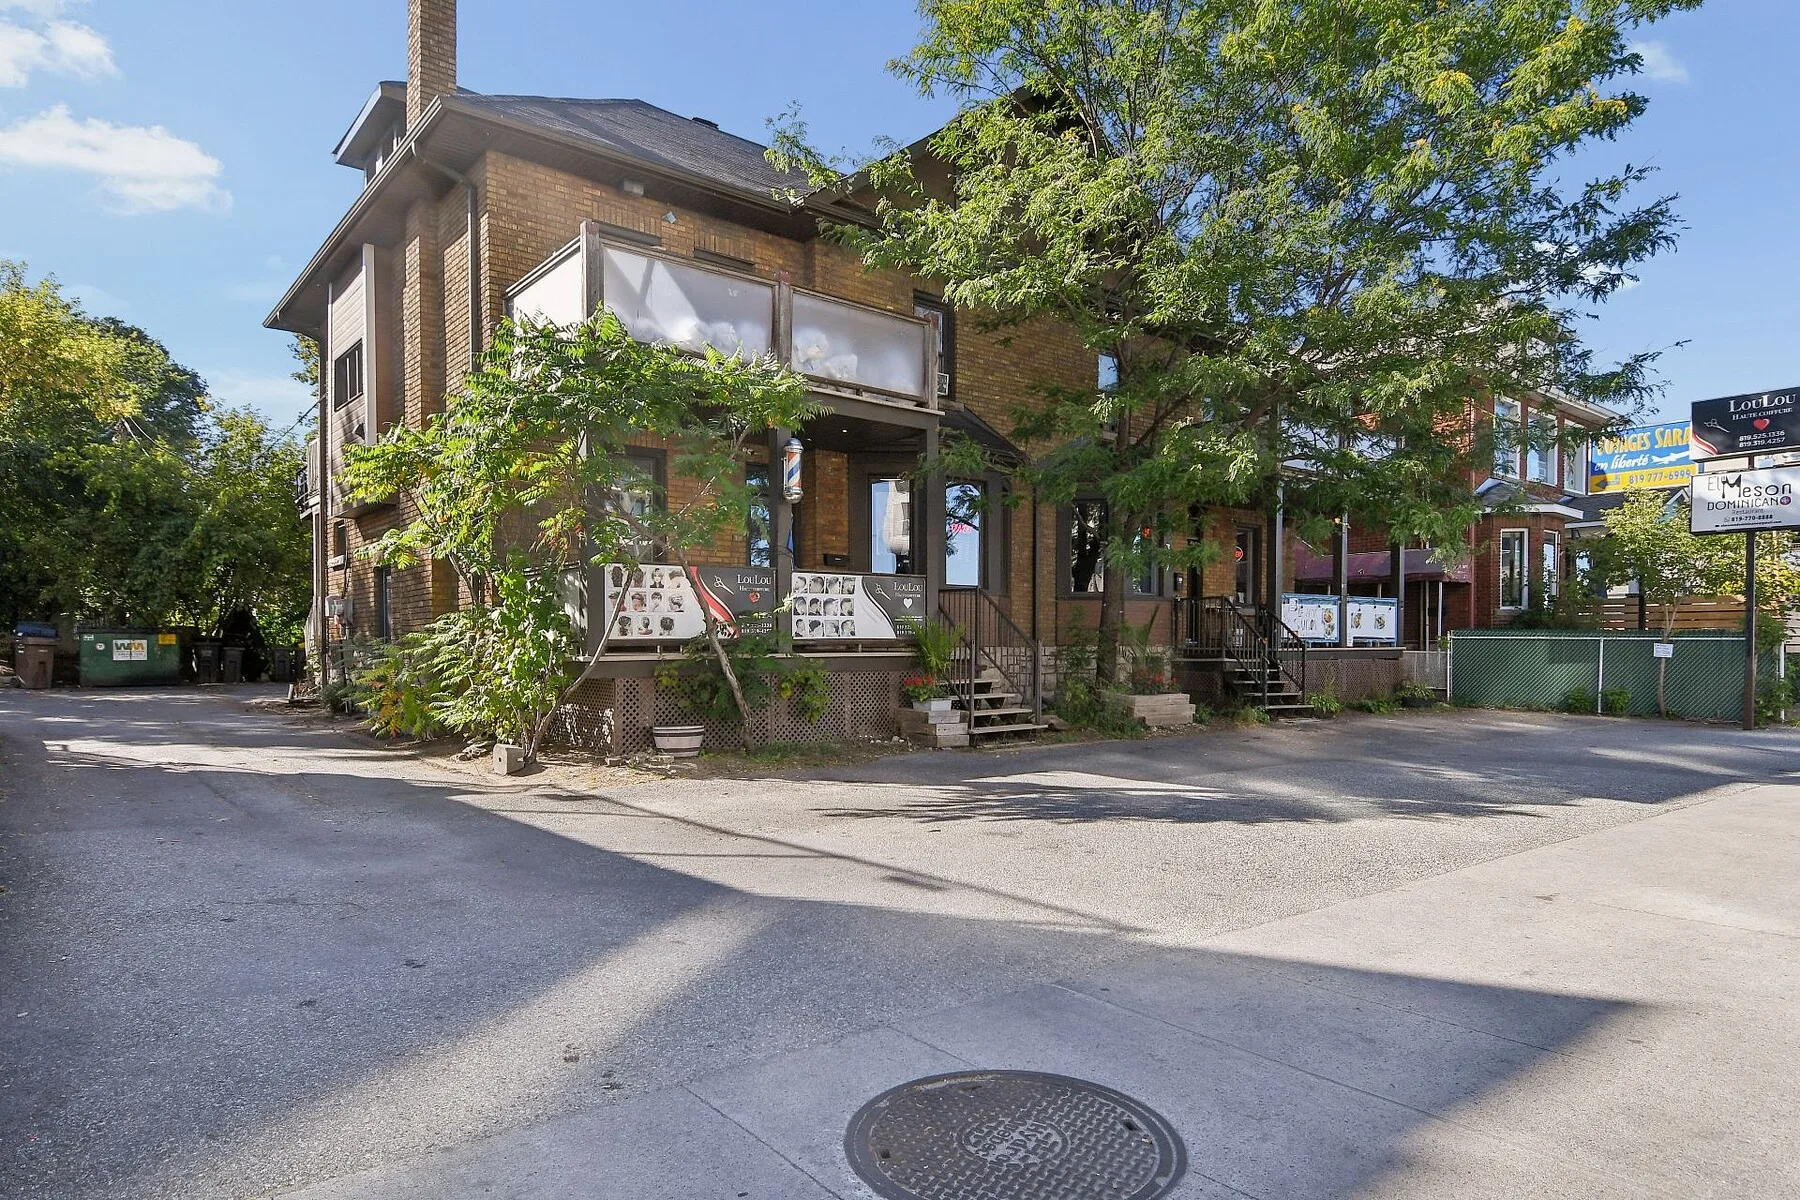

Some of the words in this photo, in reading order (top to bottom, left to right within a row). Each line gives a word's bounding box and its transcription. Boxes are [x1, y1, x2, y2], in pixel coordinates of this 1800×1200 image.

[1594, 462, 1608, 471] en
[1610, 453, 1649, 469] liberté
[1629, 474, 1645, 484] 819
[1721, 474, 1792, 499] Meson
